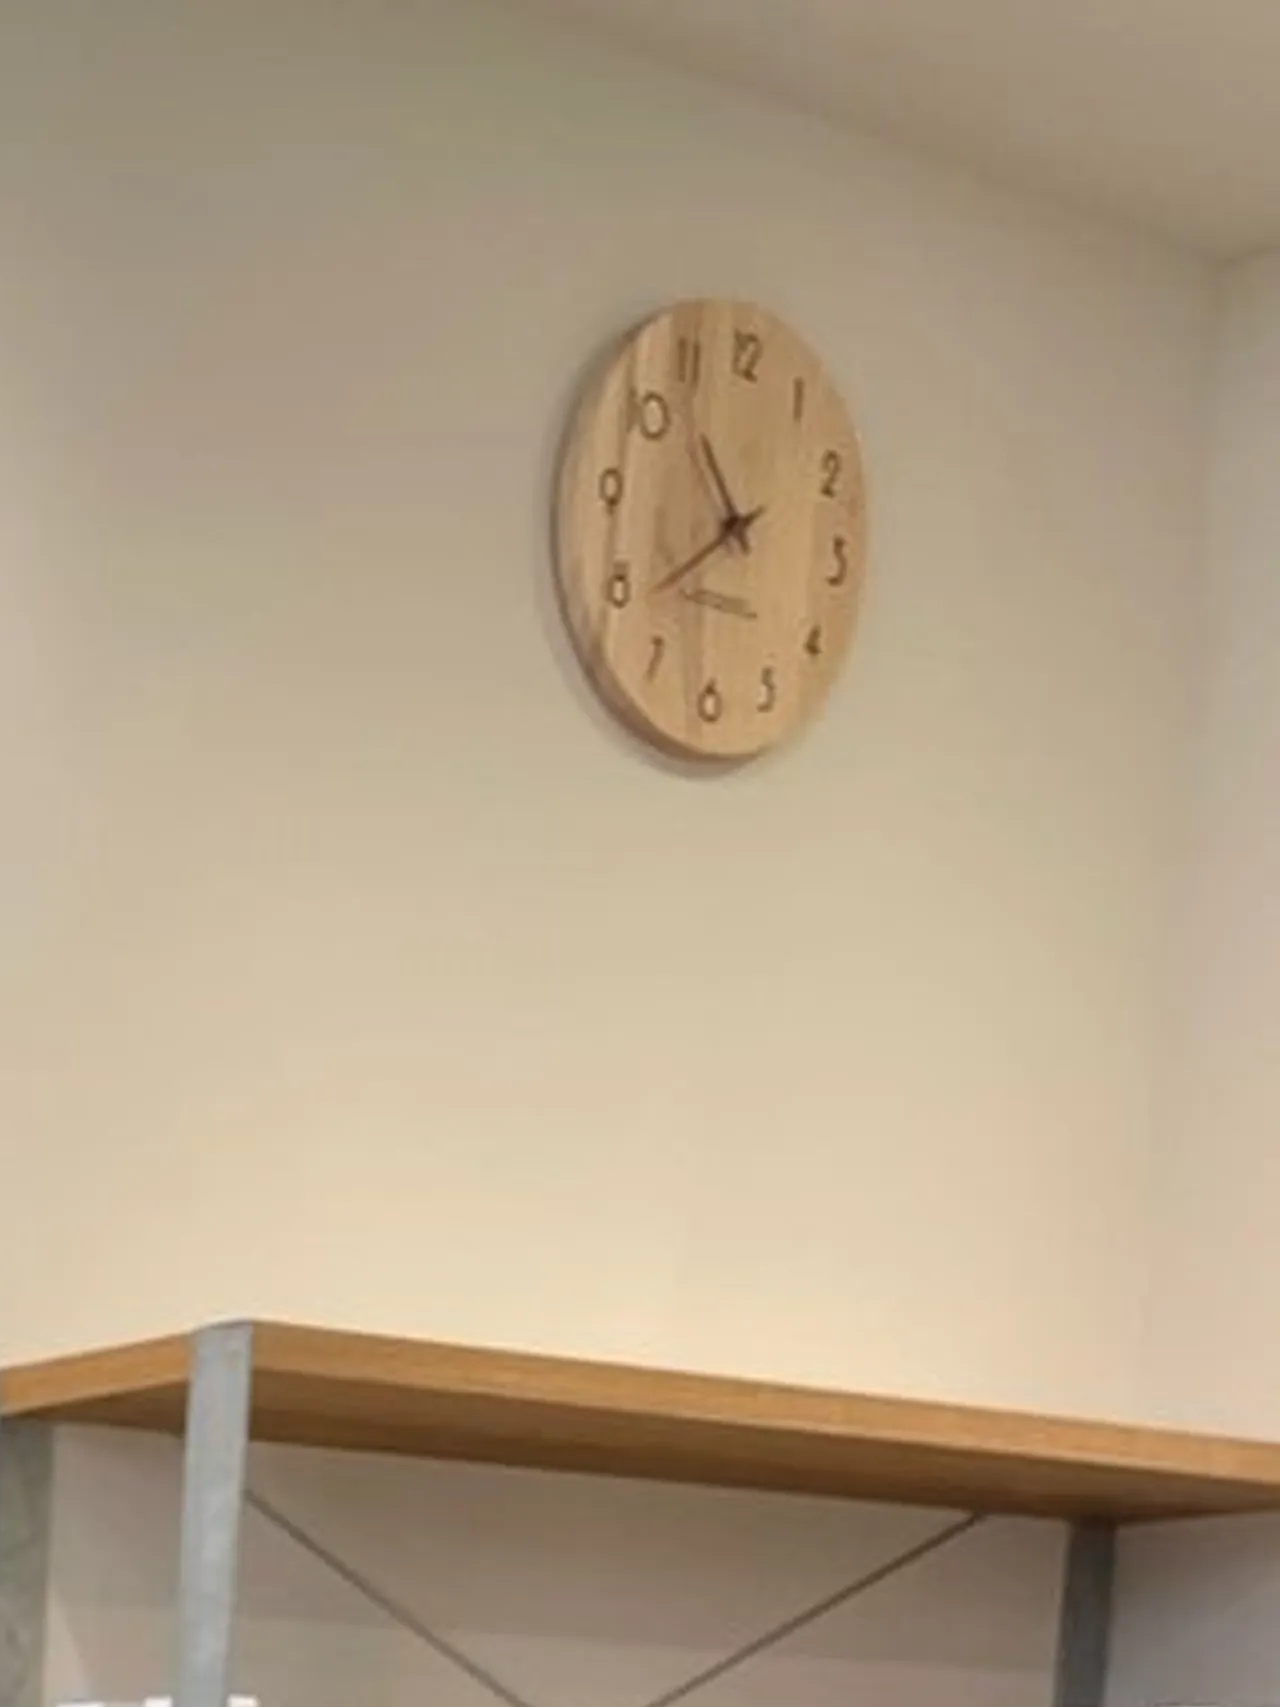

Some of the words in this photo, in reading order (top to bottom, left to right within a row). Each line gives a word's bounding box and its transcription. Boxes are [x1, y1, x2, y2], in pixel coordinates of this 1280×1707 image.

[677, 337, 701, 389] 11
[731, 327, 763, 384] 12
[792, 377, 805, 422] 1
[599, 468, 623, 516] 9
[820, 450, 842, 498] 2
[608, 562, 632, 610] 8
[826, 537, 848, 587] 3
[645, 635, 666, 684] 7
[803, 624, 823, 658] 4
[697, 678, 723, 723] 6
[756, 667, 776, 713] 5
